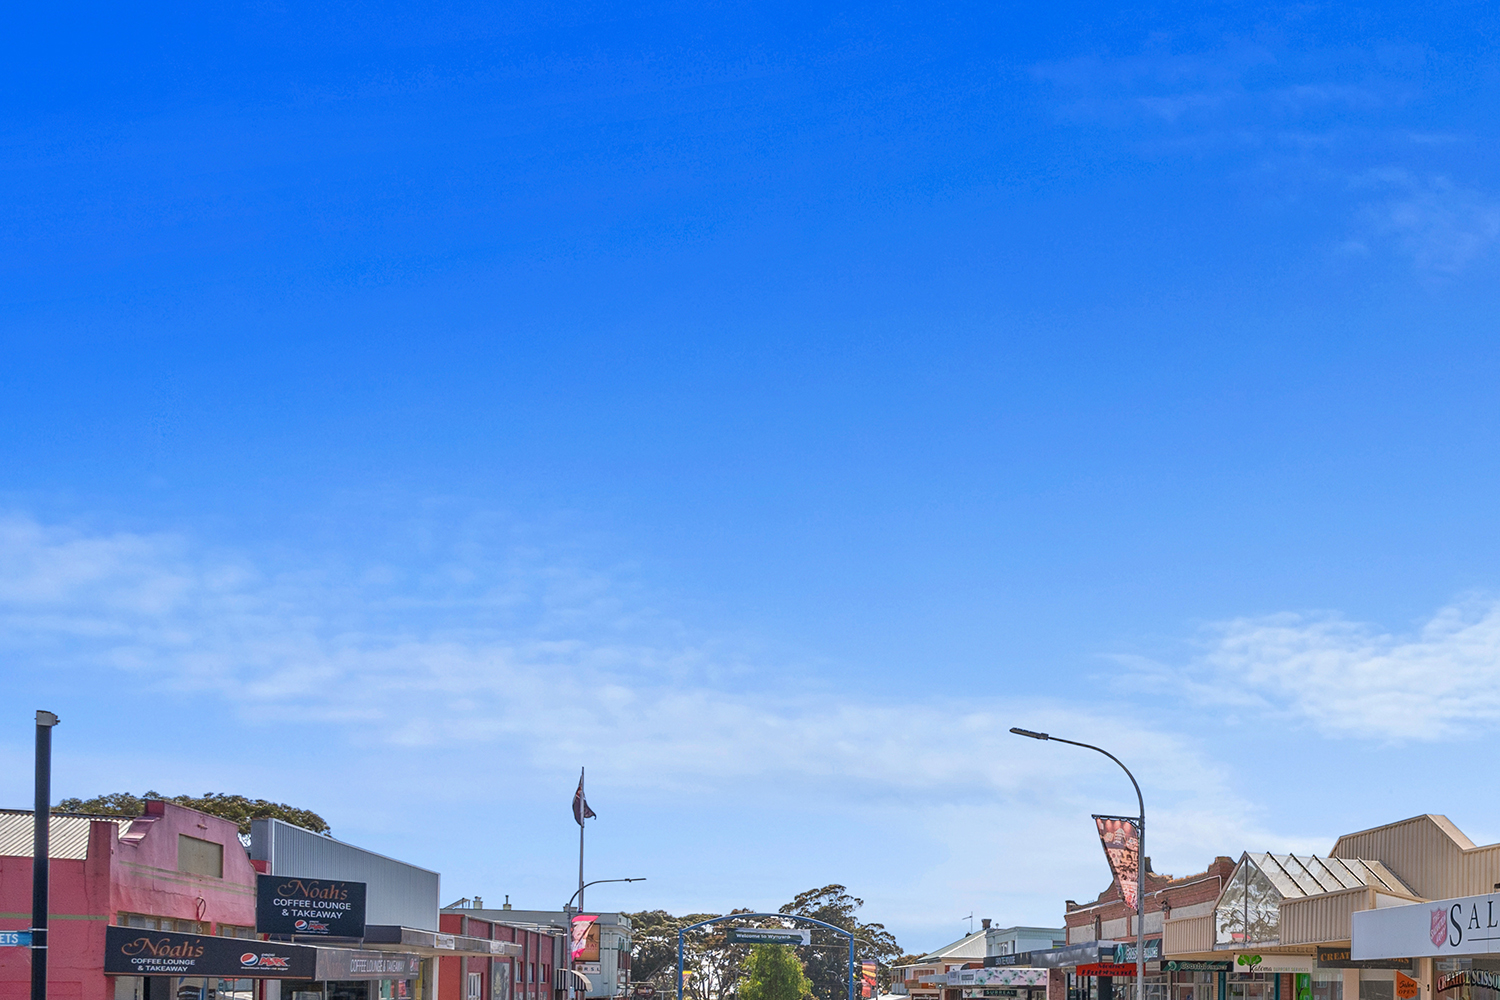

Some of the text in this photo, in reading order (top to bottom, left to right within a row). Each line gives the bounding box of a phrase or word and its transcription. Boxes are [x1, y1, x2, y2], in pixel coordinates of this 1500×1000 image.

[277, 880, 348, 900] Noah's
[273, 898, 351, 910] COFFEE LOUNGE
[281, 908, 343, 919] & TAKEAWAY
[121, 937, 204, 957] Noah's
[163, 958, 196, 966] LOUNGE
[1320, 951, 1350, 962] CREAT
[350, 959, 367, 972] COFFEE
[1437, 970, 1470, 991] CREATIVE
